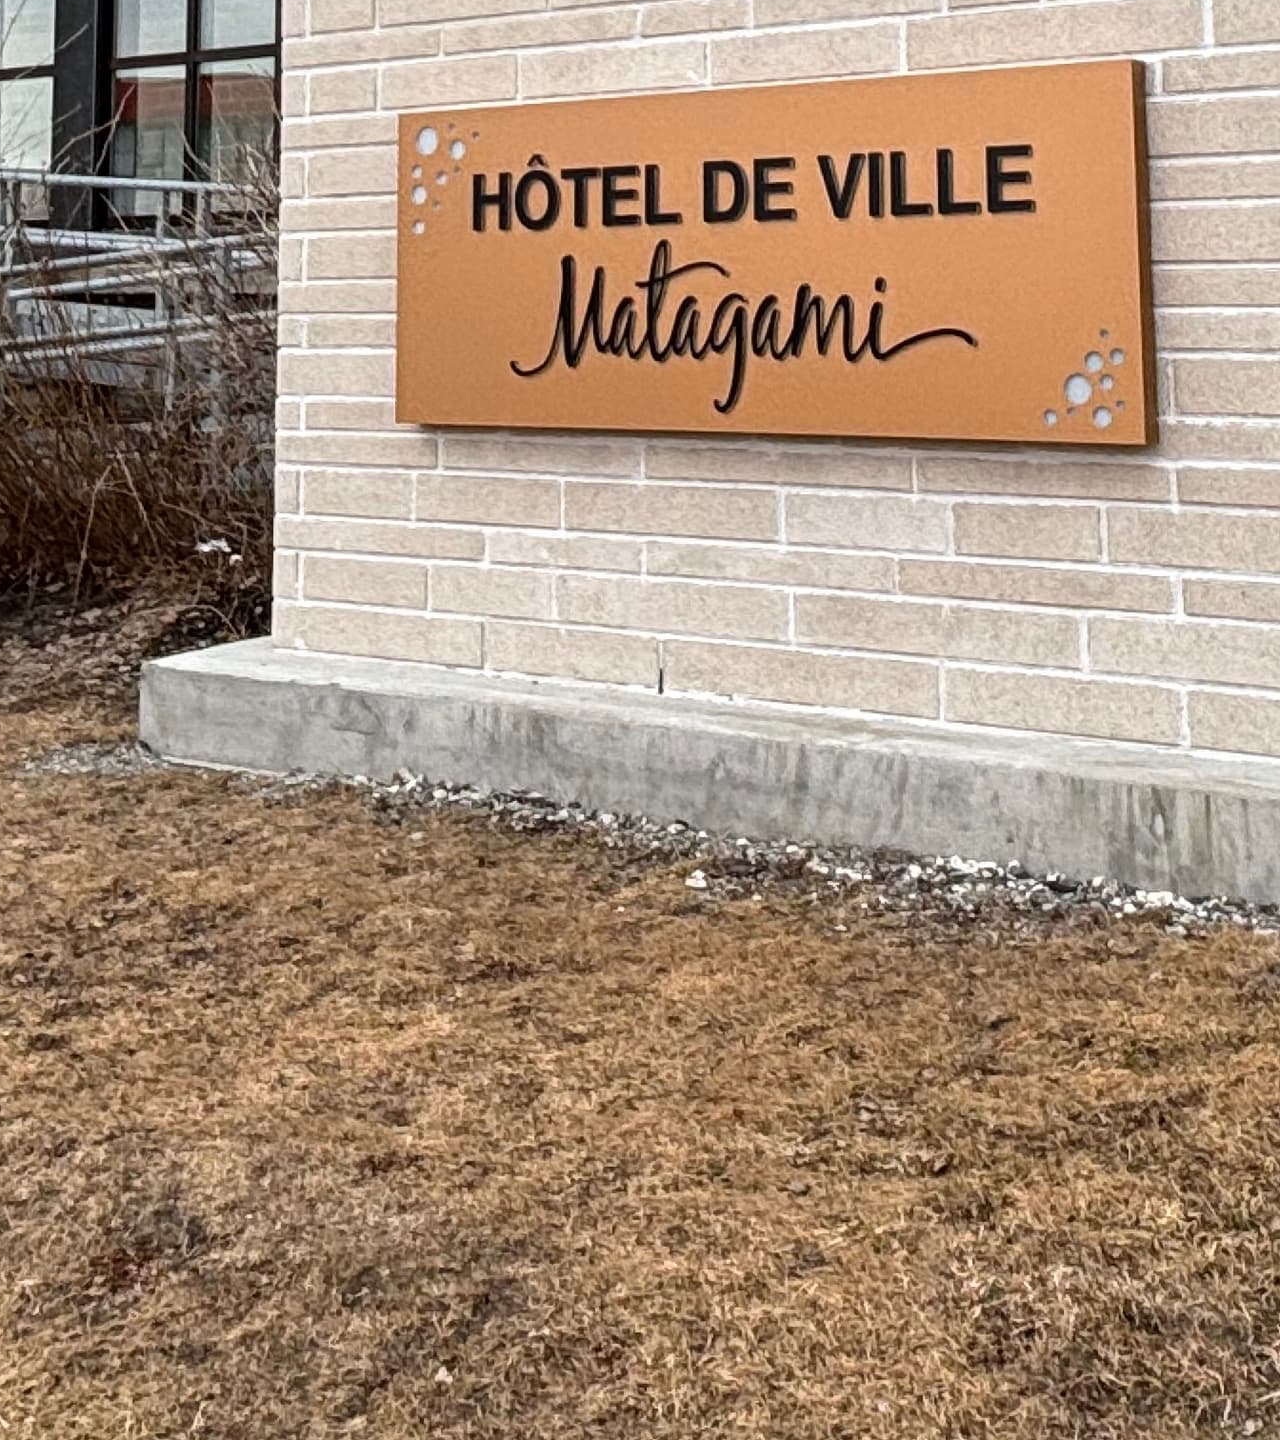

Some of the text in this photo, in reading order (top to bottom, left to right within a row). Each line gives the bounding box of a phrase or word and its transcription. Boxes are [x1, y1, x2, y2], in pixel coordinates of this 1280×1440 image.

[472, 144, 1036, 232] HÔTEL DE VILLE
[510, 240, 978, 413] Matagami
